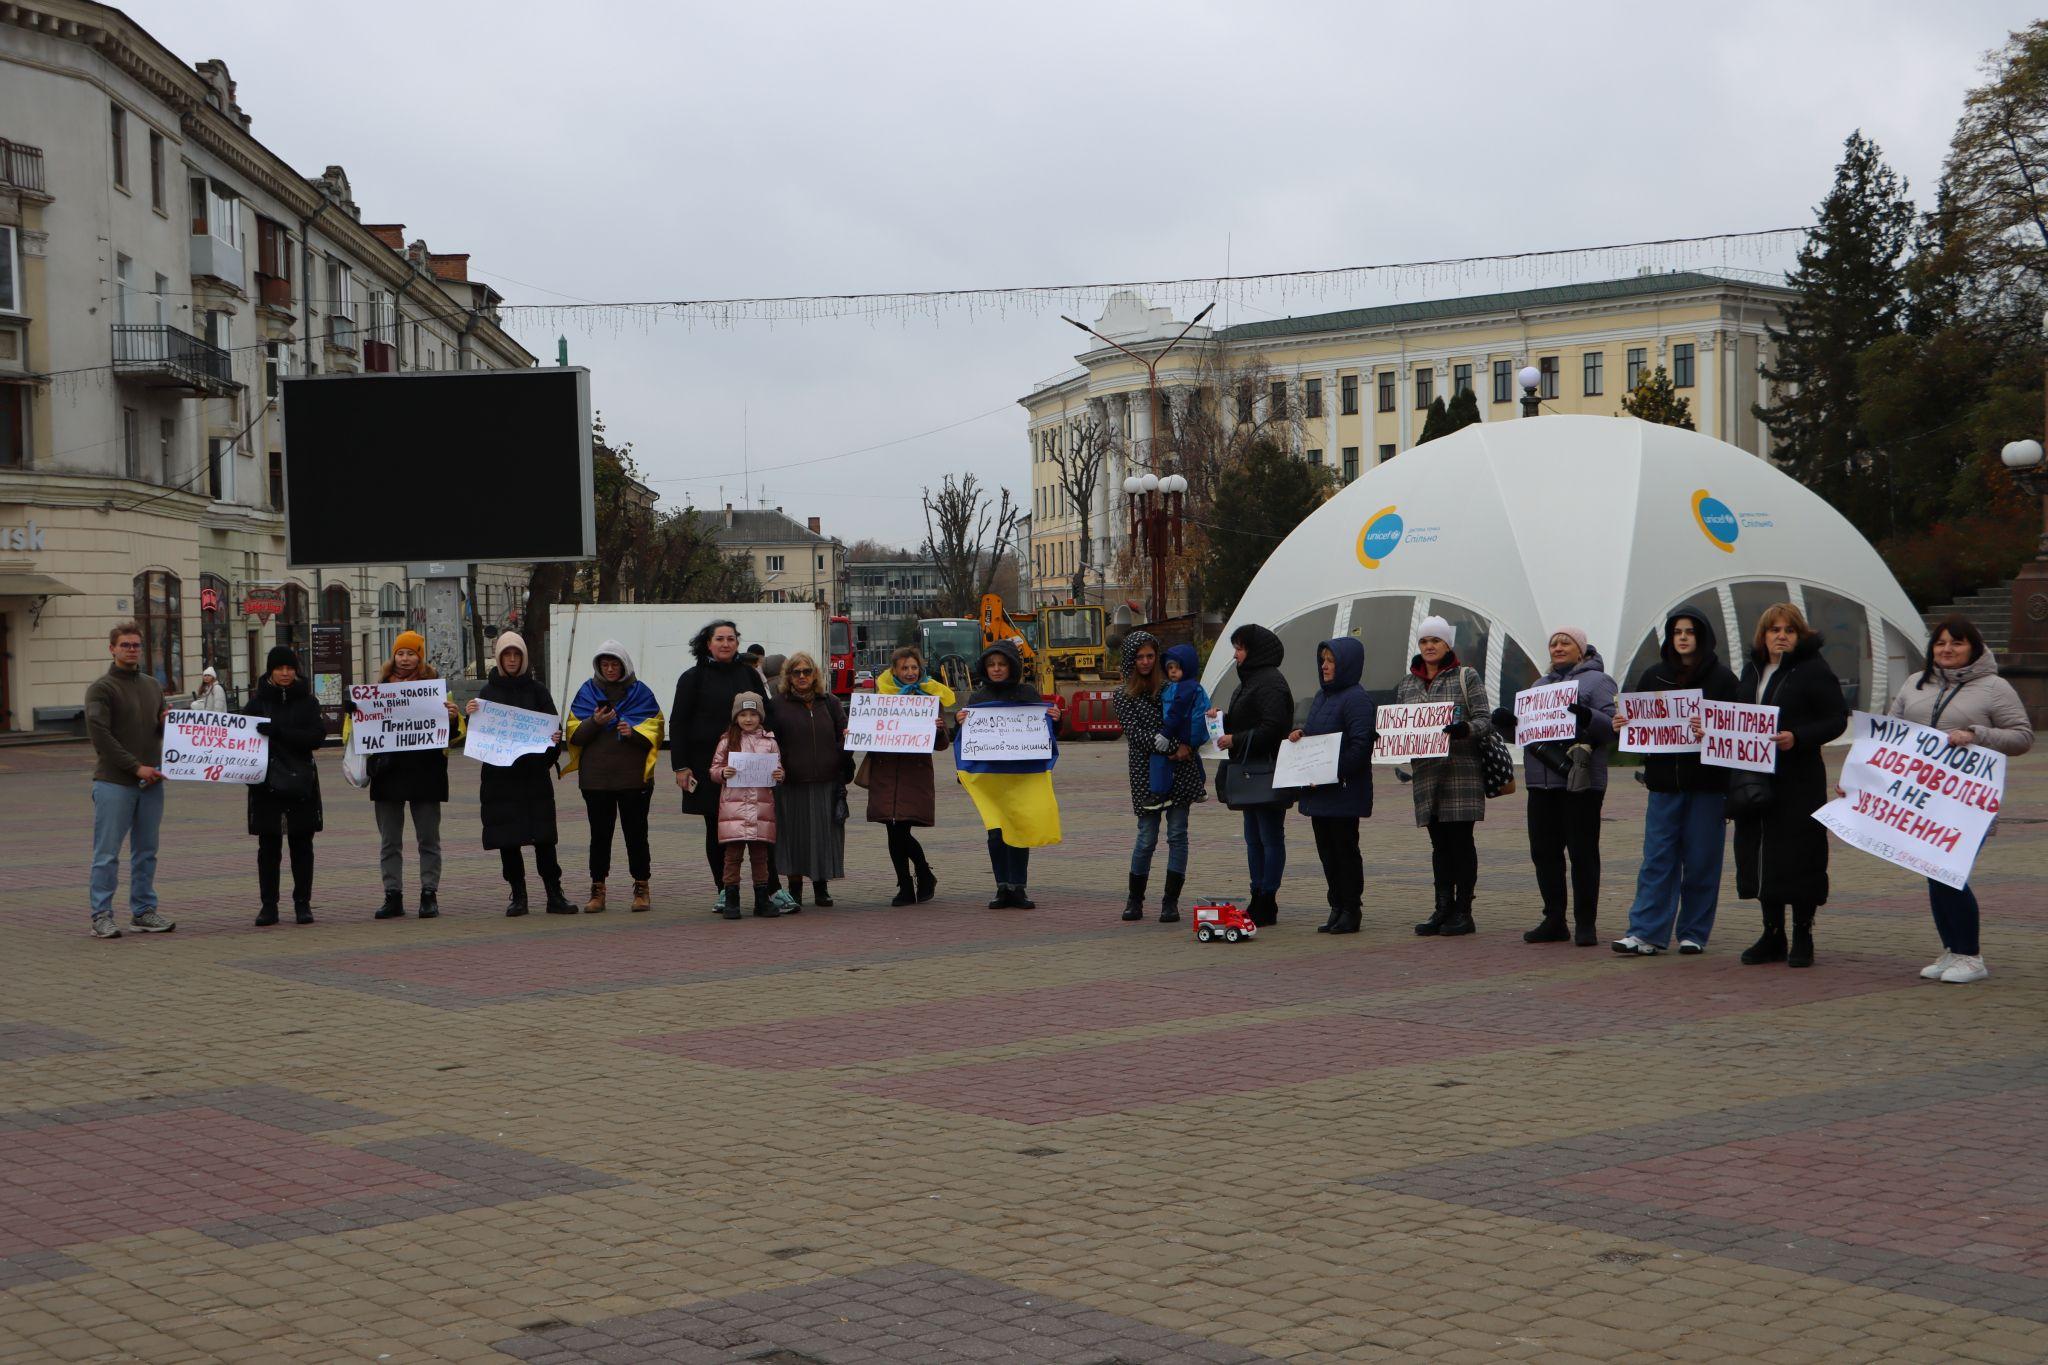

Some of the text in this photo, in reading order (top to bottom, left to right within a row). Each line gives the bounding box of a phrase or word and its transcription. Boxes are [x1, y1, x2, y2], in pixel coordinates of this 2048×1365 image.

[1366, 530, 1392, 541] unicef
[352, 685, 380, 700] 627
[400, 685, 440, 698] ЧОЛОВІК
[387, 699, 410, 708] ВІЙНІ
[858, 695, 936, 707] ЗА ПЕРЕМОГУ
[1625, 695, 1700, 719] ВІЙСЬКОВІ ТЕЖ
[851, 706, 934, 717] ВІДПОВІДАЛЬНІ
[168, 711, 247, 729] ВИМАГАЄМО
[876, 719, 900, 731] ВСІ
[1704, 704, 1775, 735] РІВНІ ПРАВА
[178, 724, 228, 738] ТЕРМІНІВ
[1559, 723, 1576, 737] ДУХ
[362, 735, 385, 749] ЧАС
[846, 732, 931, 747] ПОРА МІНЯТИСЯ
[1706, 736, 1771, 764] ДЛЯ ВСІХ
[1869, 718, 1998, 782] МІЙ ЧОЛОВІК
[169, 767, 197, 776] після
[203, 765, 224, 781] 18
[1865, 747, 2001, 814] ДОБРОВОЛЕЦЬ
[1887, 779, 1932, 810] А НЕ
